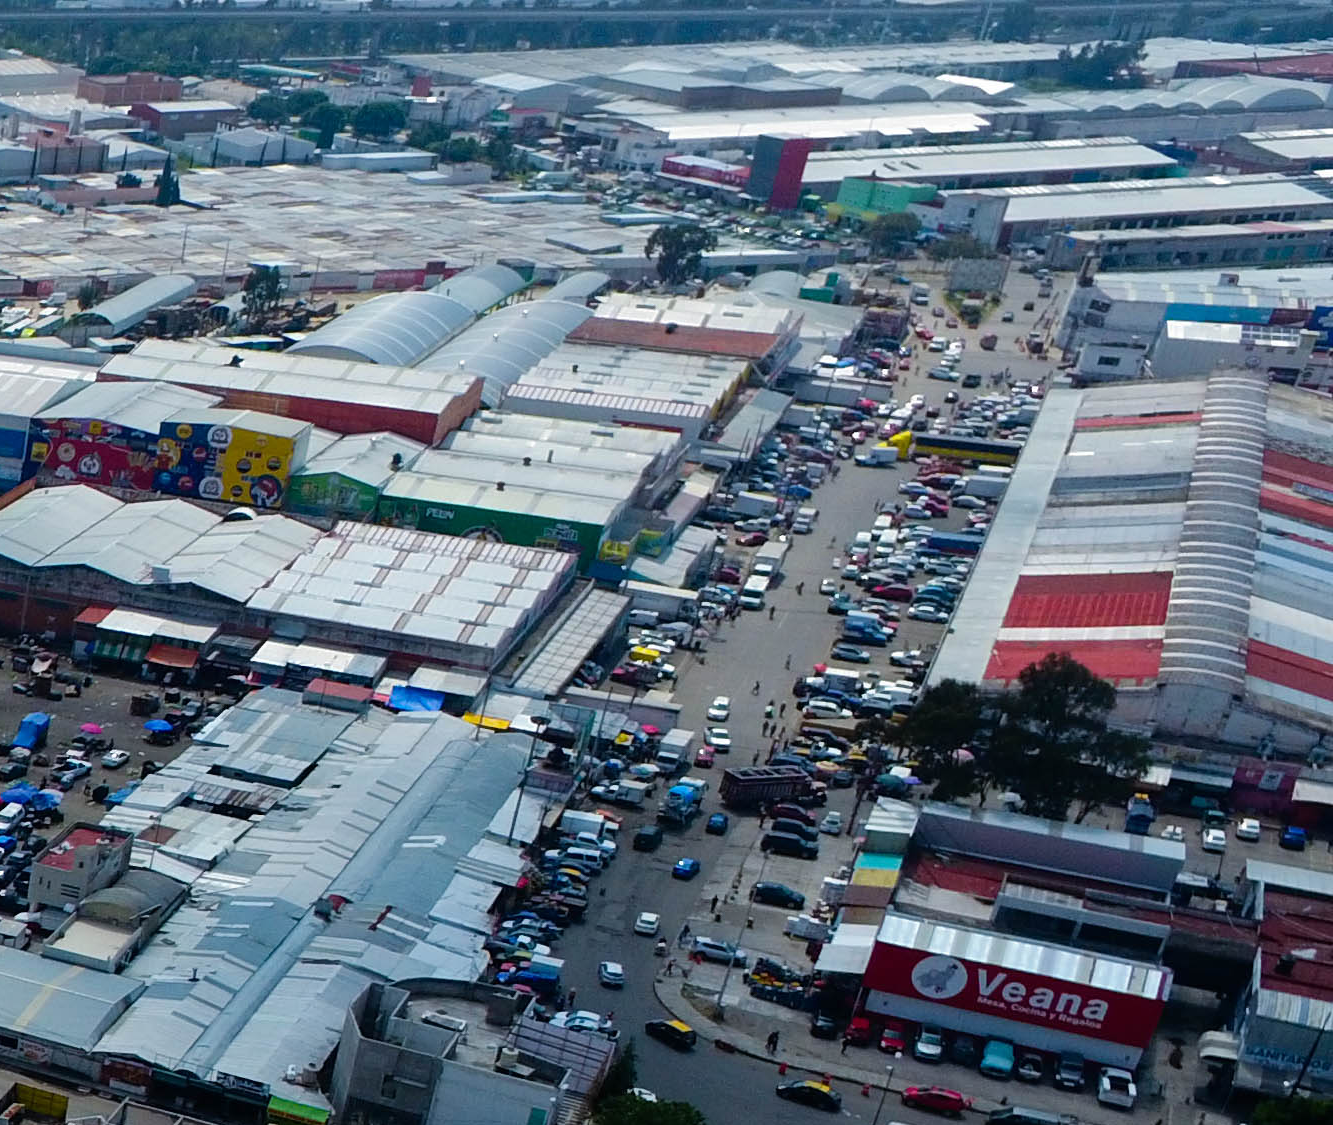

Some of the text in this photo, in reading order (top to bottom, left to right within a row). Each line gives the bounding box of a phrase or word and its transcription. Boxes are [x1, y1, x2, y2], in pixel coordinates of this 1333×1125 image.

[978, 968, 1109, 1021] Veana
[1011, 1003, 1046, 1018] Cocina
[1058, 1014, 1102, 1029] Regalos
[1244, 1045, 1331, 1071] SANITAROS
